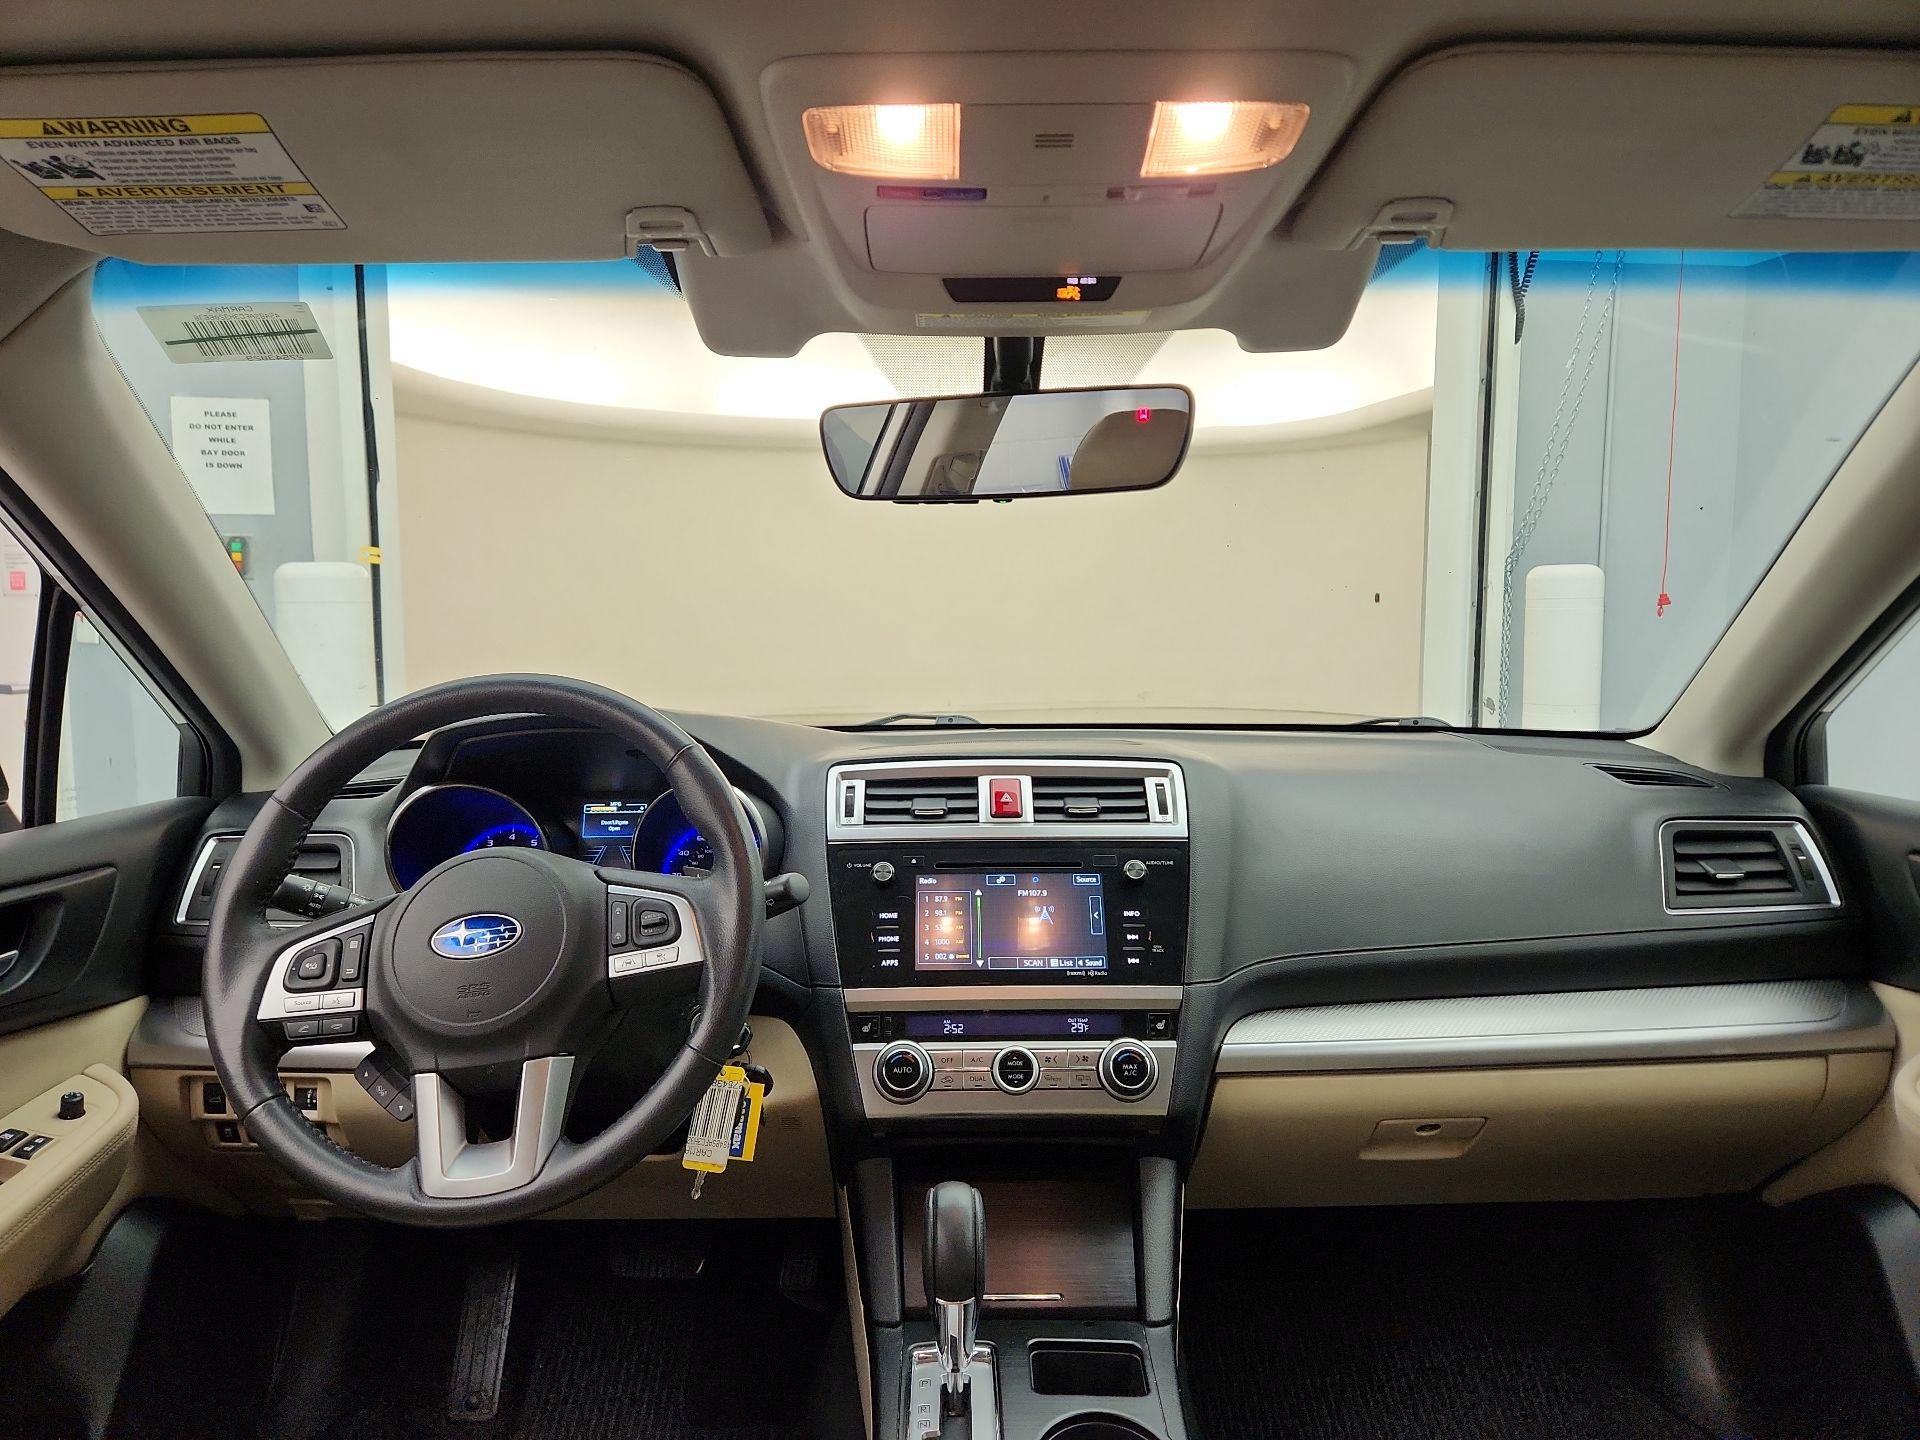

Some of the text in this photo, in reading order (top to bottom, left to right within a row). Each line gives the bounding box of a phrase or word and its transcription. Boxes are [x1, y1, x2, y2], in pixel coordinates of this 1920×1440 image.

[60, 118, 191, 135] WARNING
[26, 136, 241, 149] EVEN WITH ADVANCED AIR BAGS
[95, 184, 286, 198] AVERTISSEMENT
[486, 839, 494, 847] 3
[530, 839, 538, 847] 5
[1017, 889, 1048, 897] FM107.9
[881, 959, 899, 967] APPS
[1023, 959, 1044, 967] SCAN
[1059, 959, 1074, 967] List
[1085, 959, 1103, 967] Sound
[943, 1023, 964, 1034] 2:52
[940, 1056, 954, 1064] OFF
